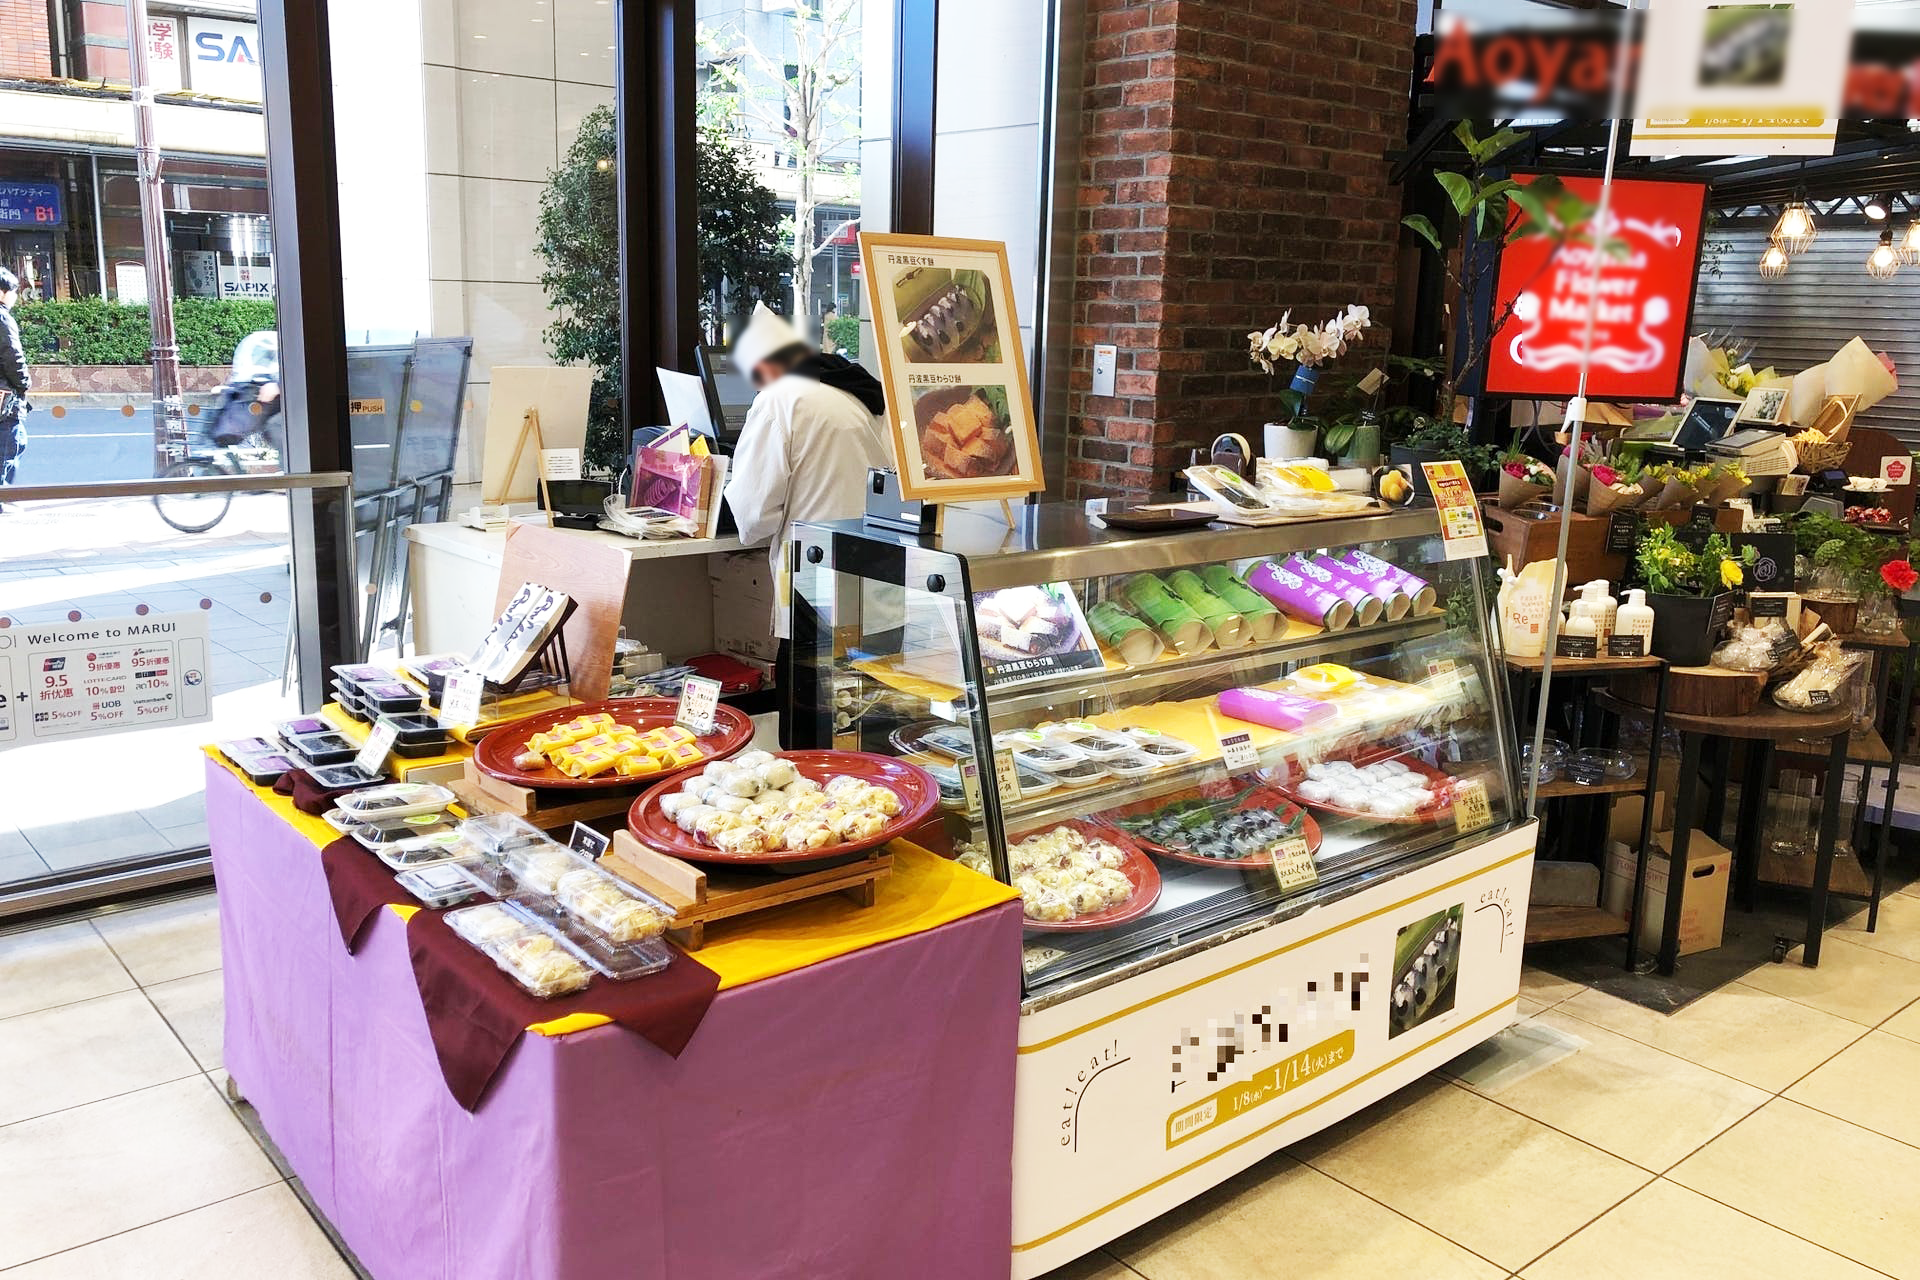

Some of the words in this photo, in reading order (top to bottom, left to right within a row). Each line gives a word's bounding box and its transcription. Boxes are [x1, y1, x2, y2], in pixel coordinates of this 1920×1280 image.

[224, 282, 269, 293] SAPIX
[1512, 612, 1529, 625] Re
[28, 631, 100, 645] Welcome
[106, 628, 121, 638] to
[127, 622, 176, 636] MARUI
[45, 674, 68, 688] 9.5
[102, 700, 121, 708] UOB
[1480, 888, 1507, 904] eat!
[1503, 898, 1514, 937] eat!
[1077, 1039, 1118, 1083] eat!
[1060, 1087, 1078, 1146] eat!
[1174, 1107, 1213, 1134] 期間限定
